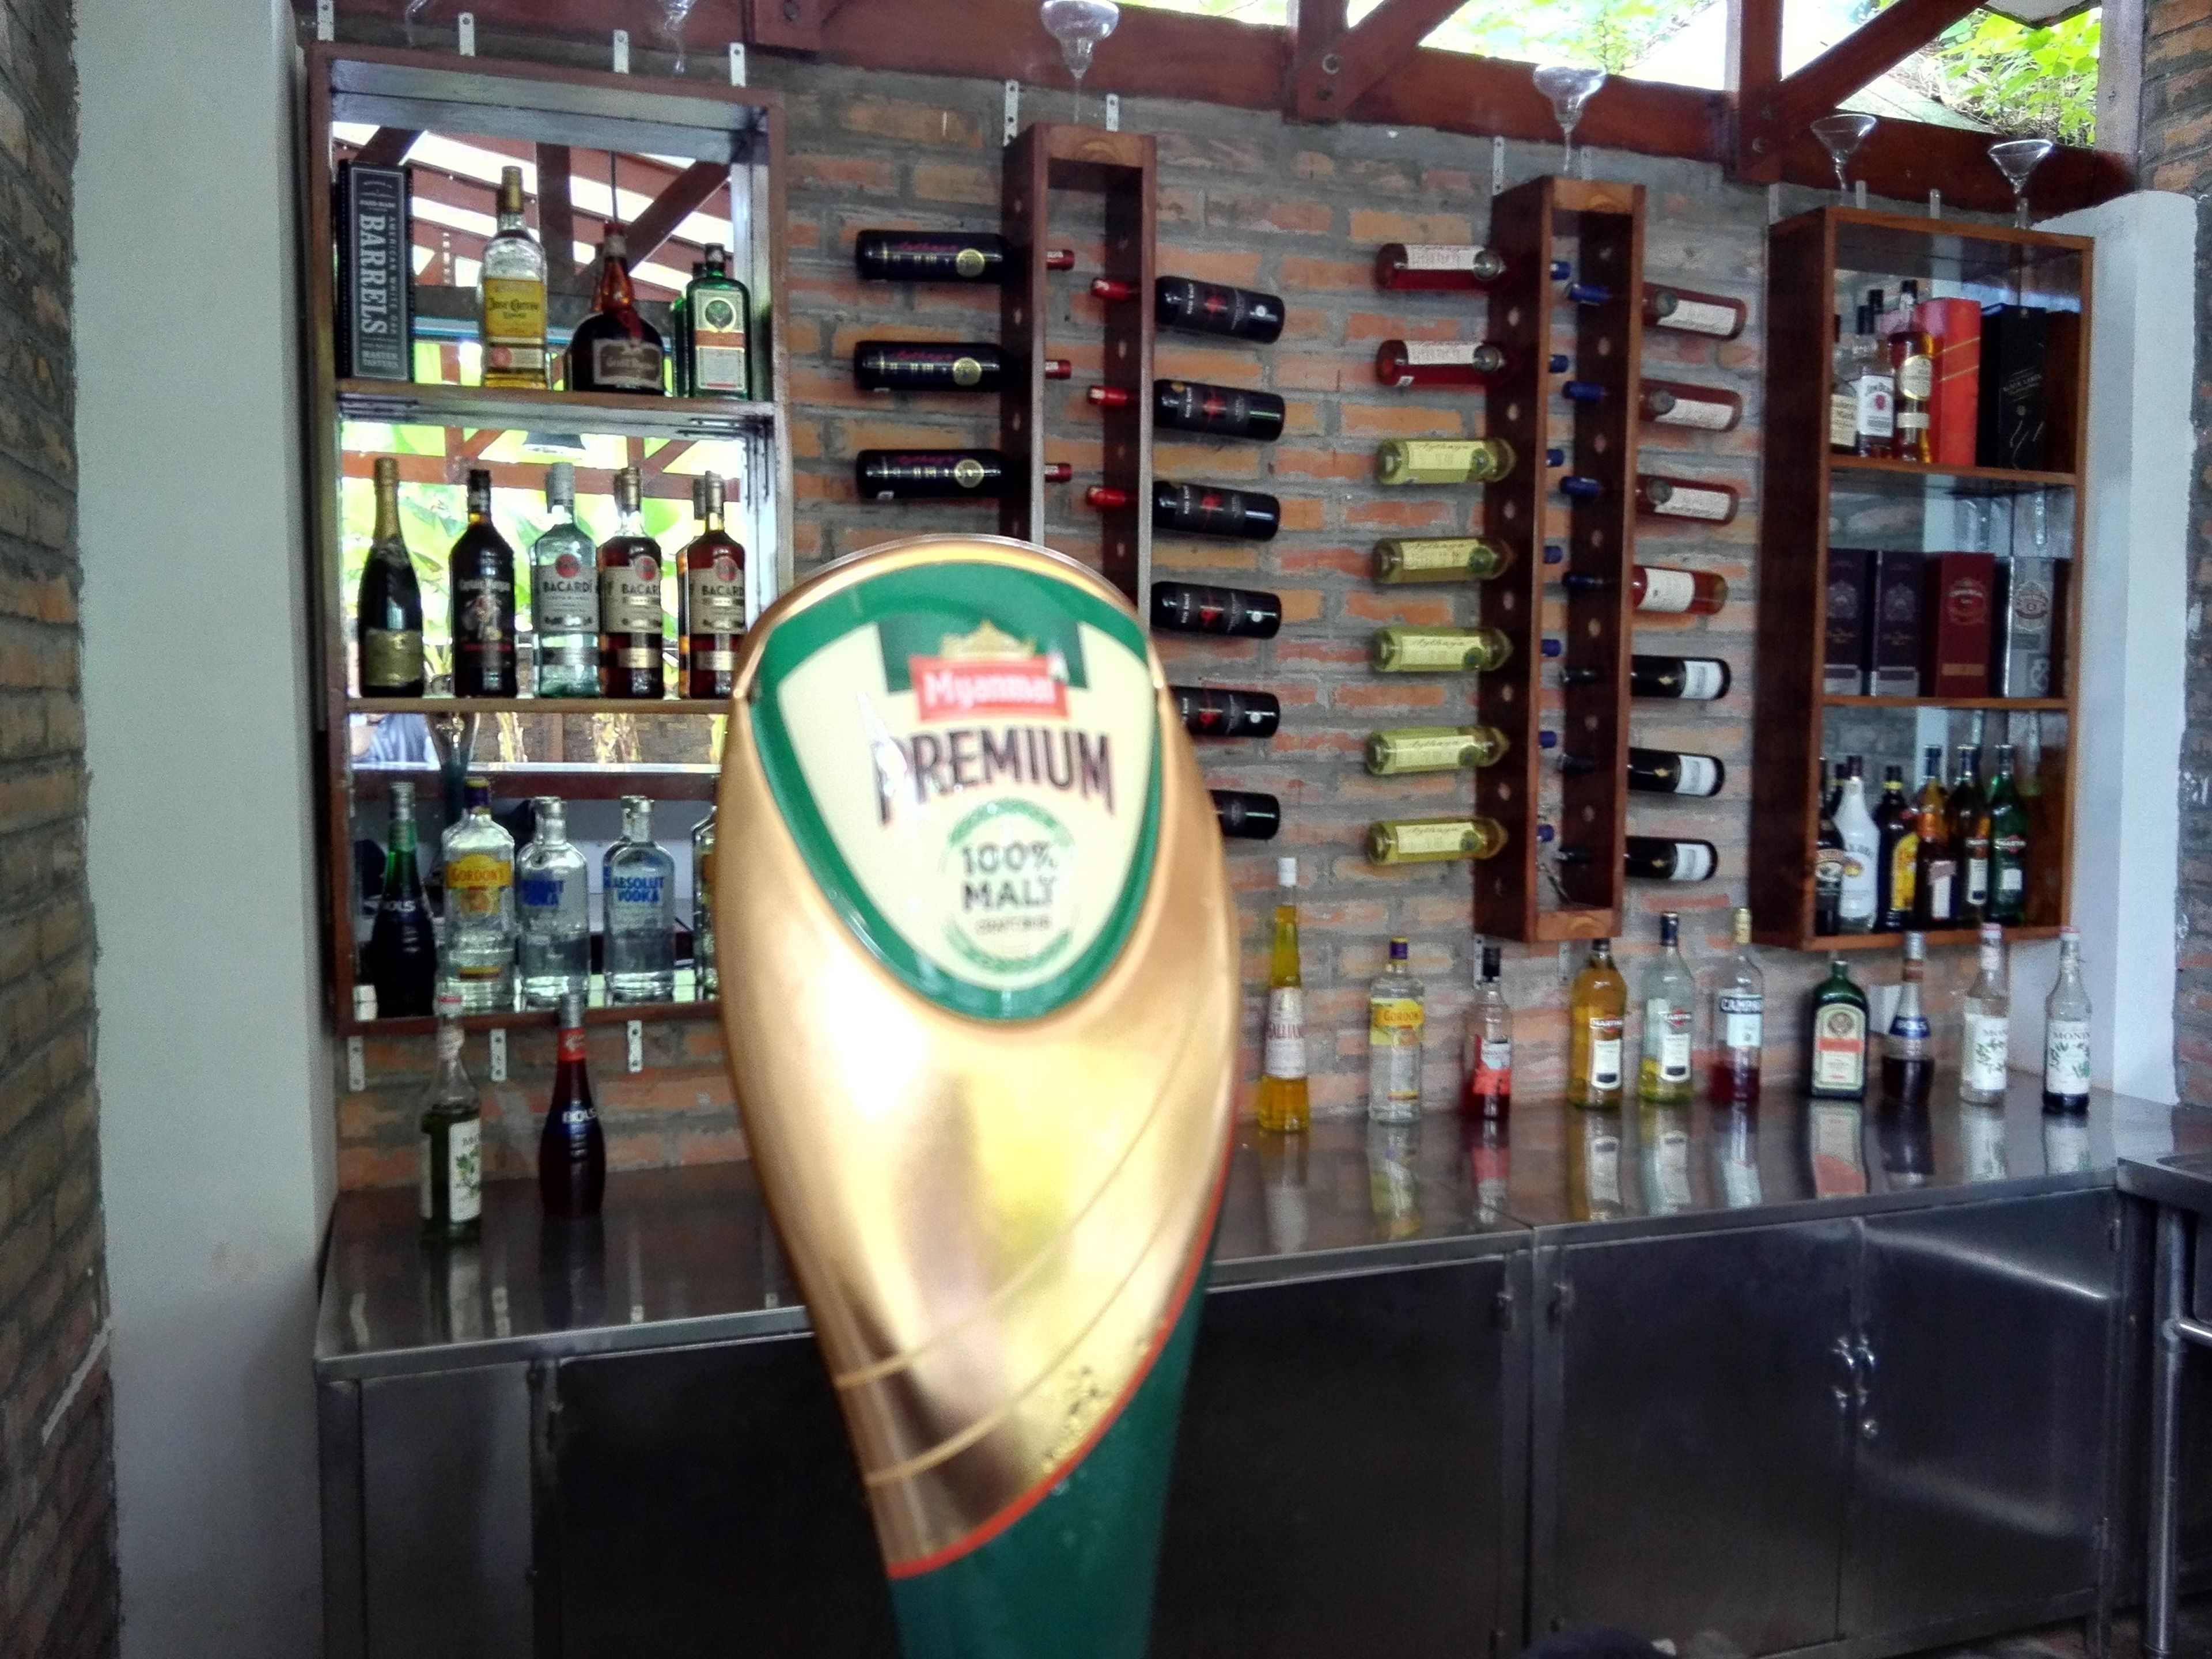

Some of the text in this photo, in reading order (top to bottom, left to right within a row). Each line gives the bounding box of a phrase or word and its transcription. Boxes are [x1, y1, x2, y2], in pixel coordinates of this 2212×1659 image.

[359, 213, 388, 334] BARRELS
[870, 724, 1118, 826] PREMIUM
[963, 840, 1056, 876] 100%
[963, 877, 1056, 914] MALT
